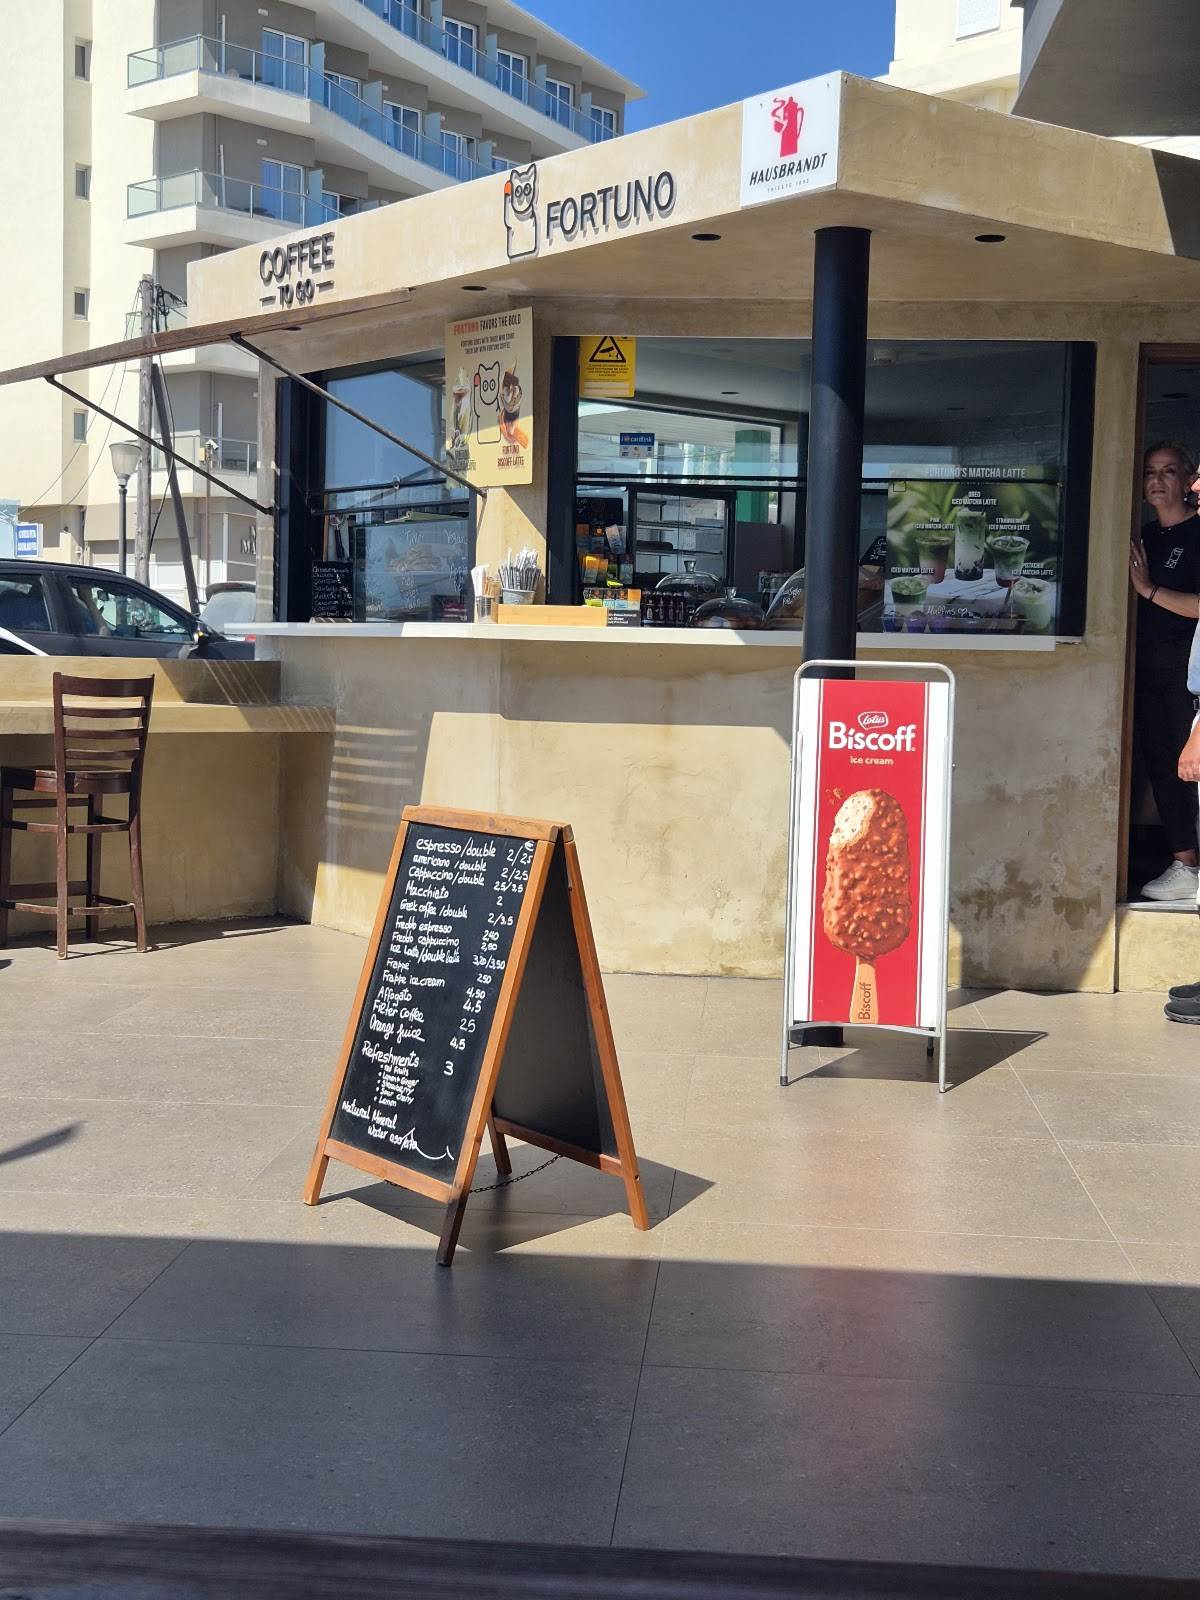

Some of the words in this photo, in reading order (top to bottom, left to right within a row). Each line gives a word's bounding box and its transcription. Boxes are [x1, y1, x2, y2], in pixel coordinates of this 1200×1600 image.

[749, 153, 827, 186] HAUSBRANDT
[546, 171, 675, 241] FORTUNO
[260, 232, 335, 285] COFFEE
[278, 284, 293, 307] TO
[296, 279, 315, 304] GO
[480, 318, 498, 331] FAVORS
[499, 316, 507, 327] THE
[508, 314, 521, 325] BOLD
[498, 457, 512, 467] BISCOFF
[512, 456, 525, 466] LATTE
[968, 467, 1001, 478] MATCHA
[1002, 468, 1025, 479] LATTE
[963, 498, 982, 506] MATCHA
[863, 714, 885, 725] Lotus
[829, 721, 916, 752] Biscoff
[850, 756, 864, 765] ice
[865, 757, 894, 766] cream
[525, 840, 535, 852] €
[412, 854, 451, 868] americano
[405, 880, 449, 899] Macchiato
[496, 896, 504, 906] 2
[400, 898, 418, 912] Greek
[418, 901, 437, 918] coffee
[395, 915, 417, 930] Freddo
[418, 921, 453, 934] espresso
[391, 931, 414, 943] Freddo
[417, 933, 460, 948] cappuccino
[372, 999, 399, 1017] Filter
[377, 985, 413, 1007] Affogato
[463, 998, 483, 1014] 4,5
[858, 982, 872, 1020] Biscoff
[369, 1013, 395, 1040] Orange
[449, 1036, 466, 1050] 4,5
[362, 1040, 420, 1068] Refreshments
[443, 1060, 454, 1076] 3
[378, 1096, 397, 1107] Lemon
[341, 1098, 371, 1120] Natural
[372, 1109, 398, 1130] Mineral
